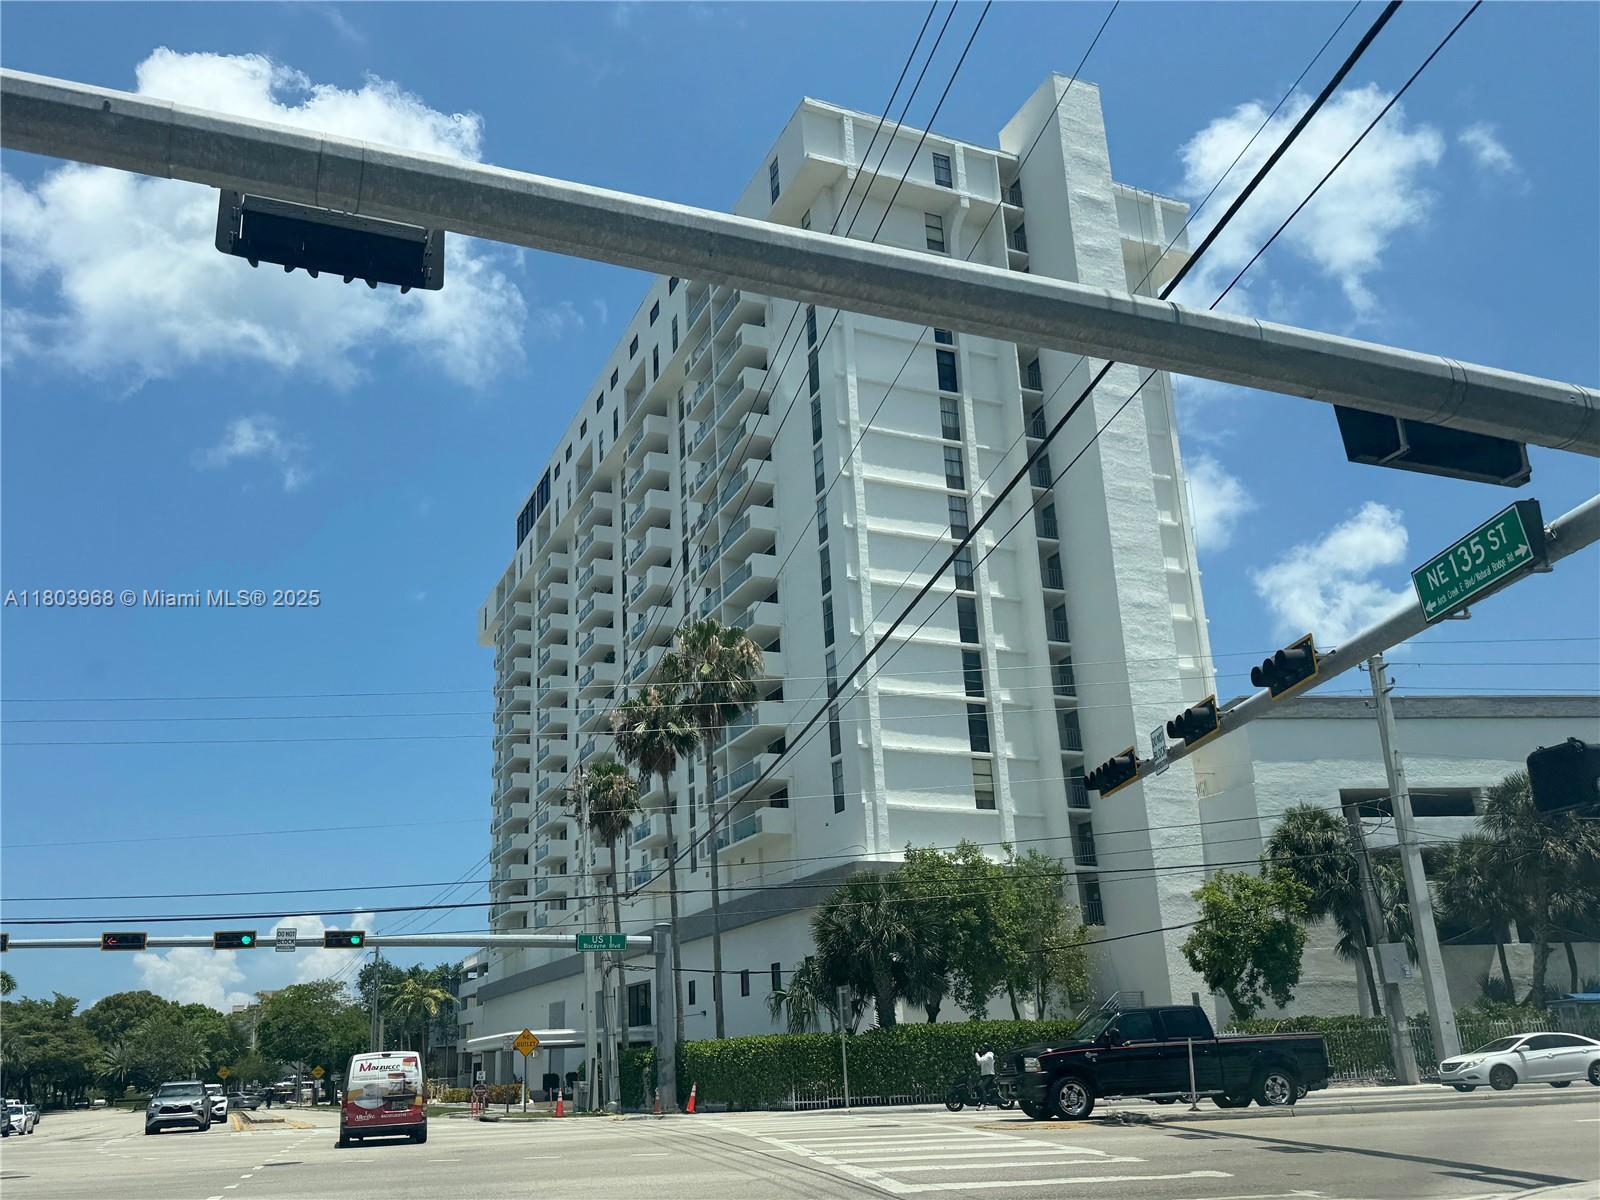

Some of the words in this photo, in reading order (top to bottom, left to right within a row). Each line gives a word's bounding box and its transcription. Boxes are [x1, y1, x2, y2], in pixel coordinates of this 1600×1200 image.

[1426, 562, 1449, 591] NE
[1448, 536, 1485, 578] 135
[1487, 522, 1508, 551] ST
[1506, 552, 1515, 563] Rd
[591, 935, 604, 944] US
[609, 935, 613, 944] 1
